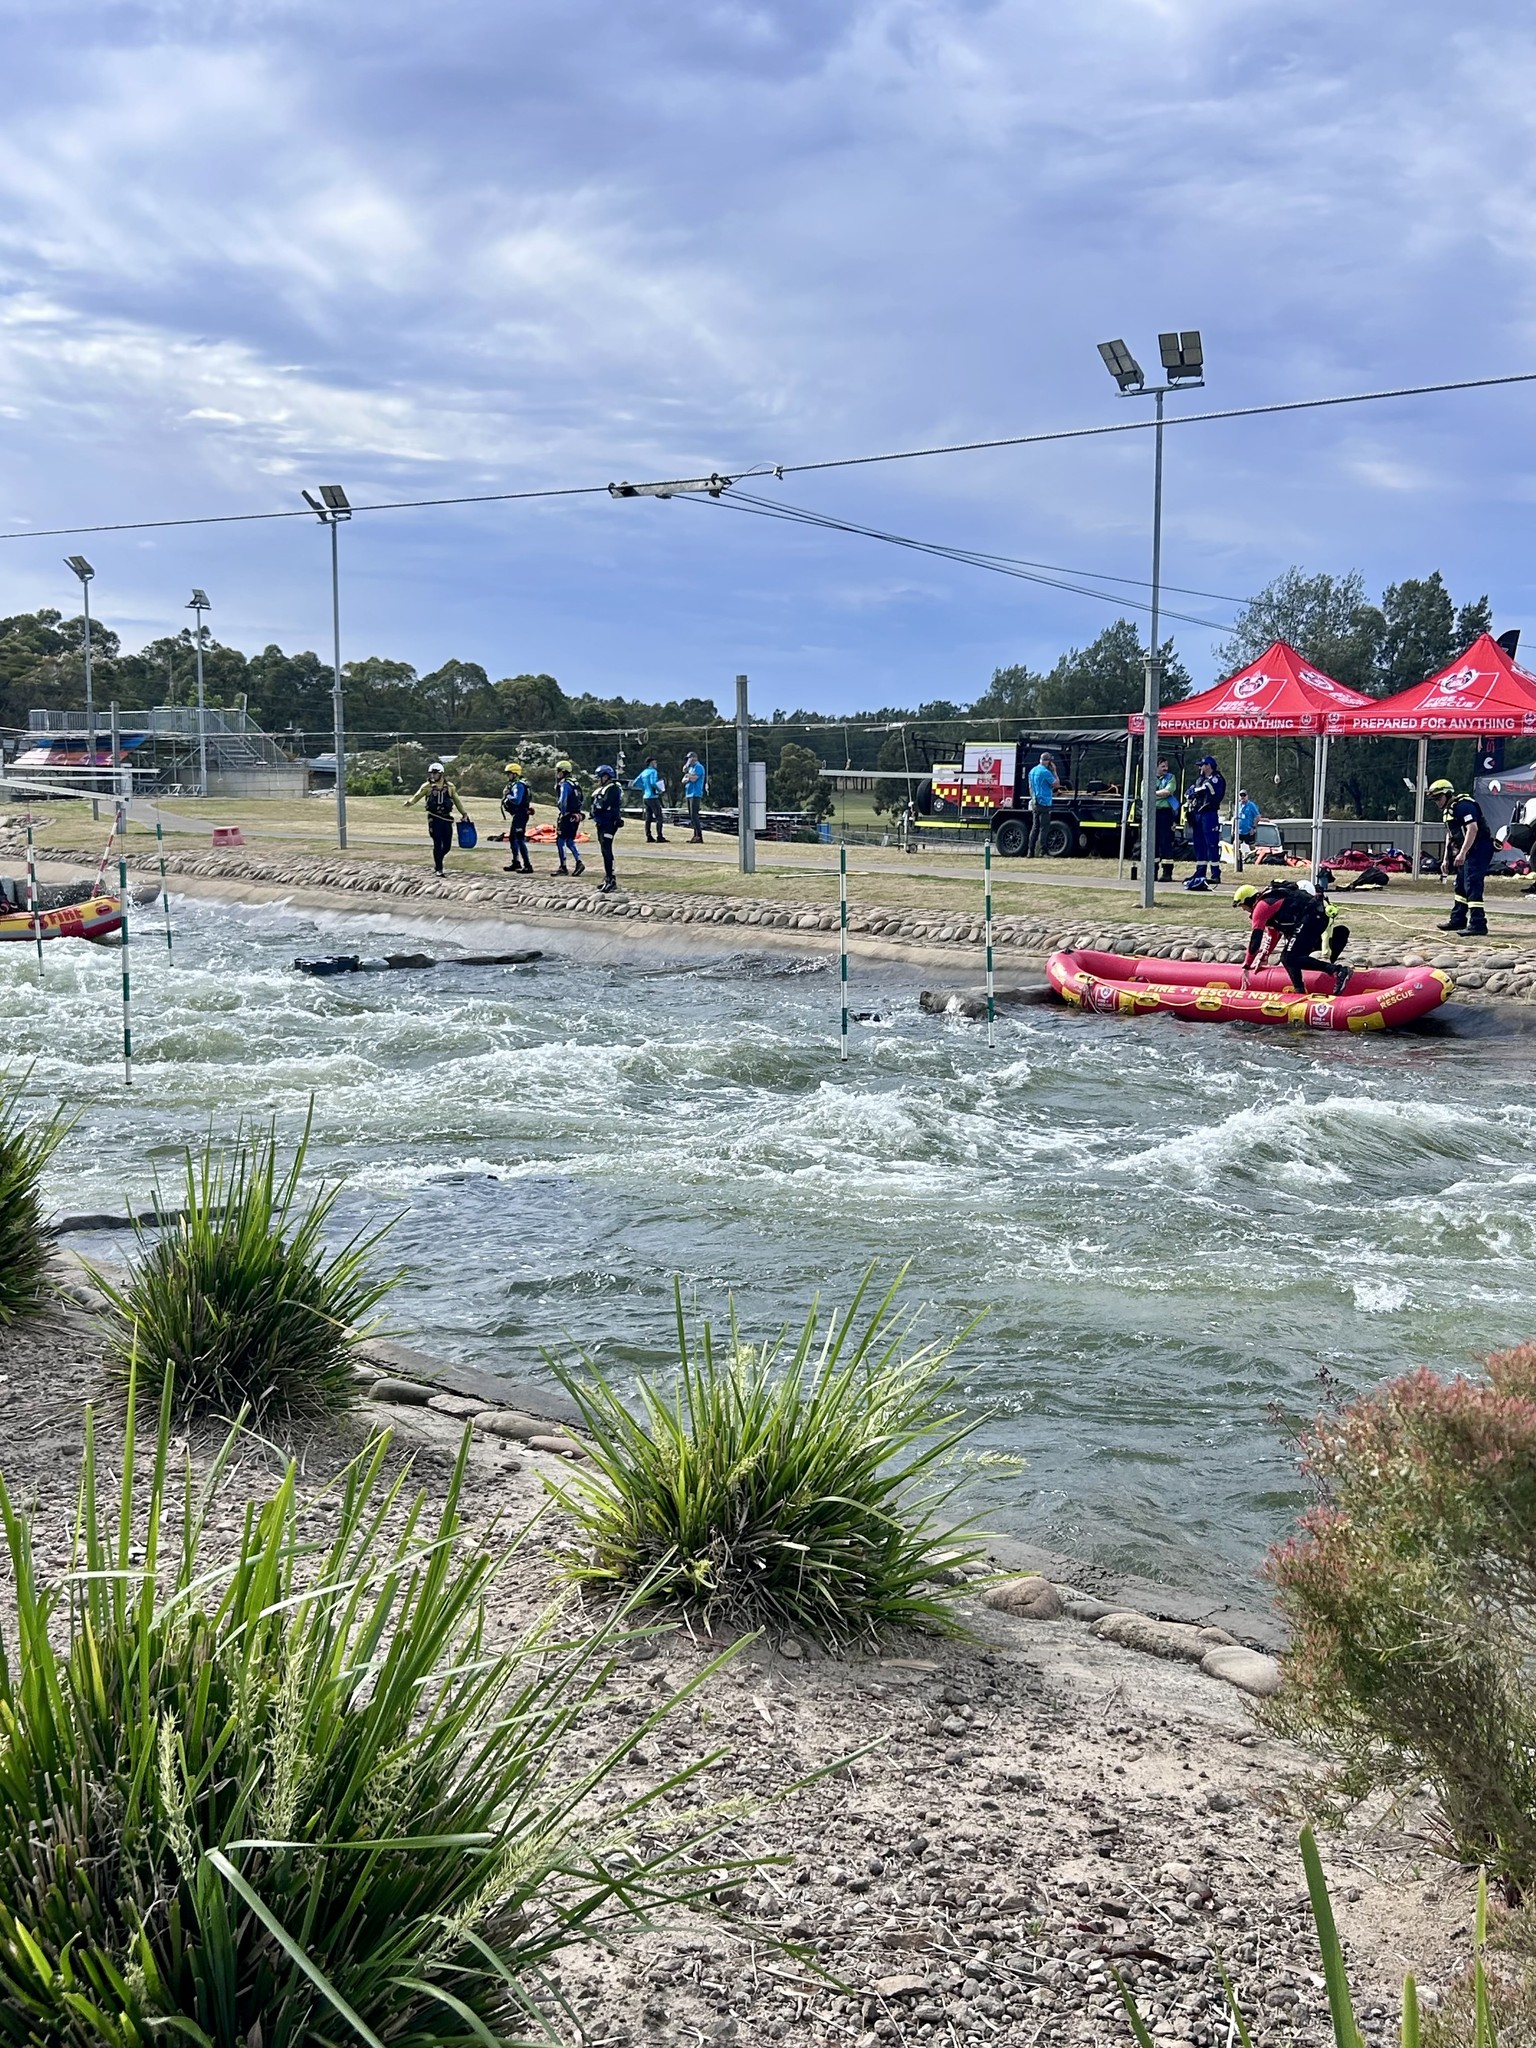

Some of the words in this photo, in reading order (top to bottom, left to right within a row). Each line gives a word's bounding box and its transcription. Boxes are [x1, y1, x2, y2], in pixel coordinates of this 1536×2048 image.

[1157, 719, 1209, 730] PREPARED
[1212, 719, 1235, 729] FOR
[1236, 718, 1294, 729] ANYTHING
[1353, 717, 1418, 729] PREPARED
[1420, 717, 1446, 729] FOR
[1450, 717, 1515, 729] ANYTHING
[48, 907, 84, 925] FIRE
[1146, 983, 1177, 994] FIRE
[1191, 987, 1245, 999] RESCUE
[1247, 991, 1284, 1001] NSW
[1376, 989, 1397, 1003] FIRE
[1379, 989, 1415, 1010] RESCUE
